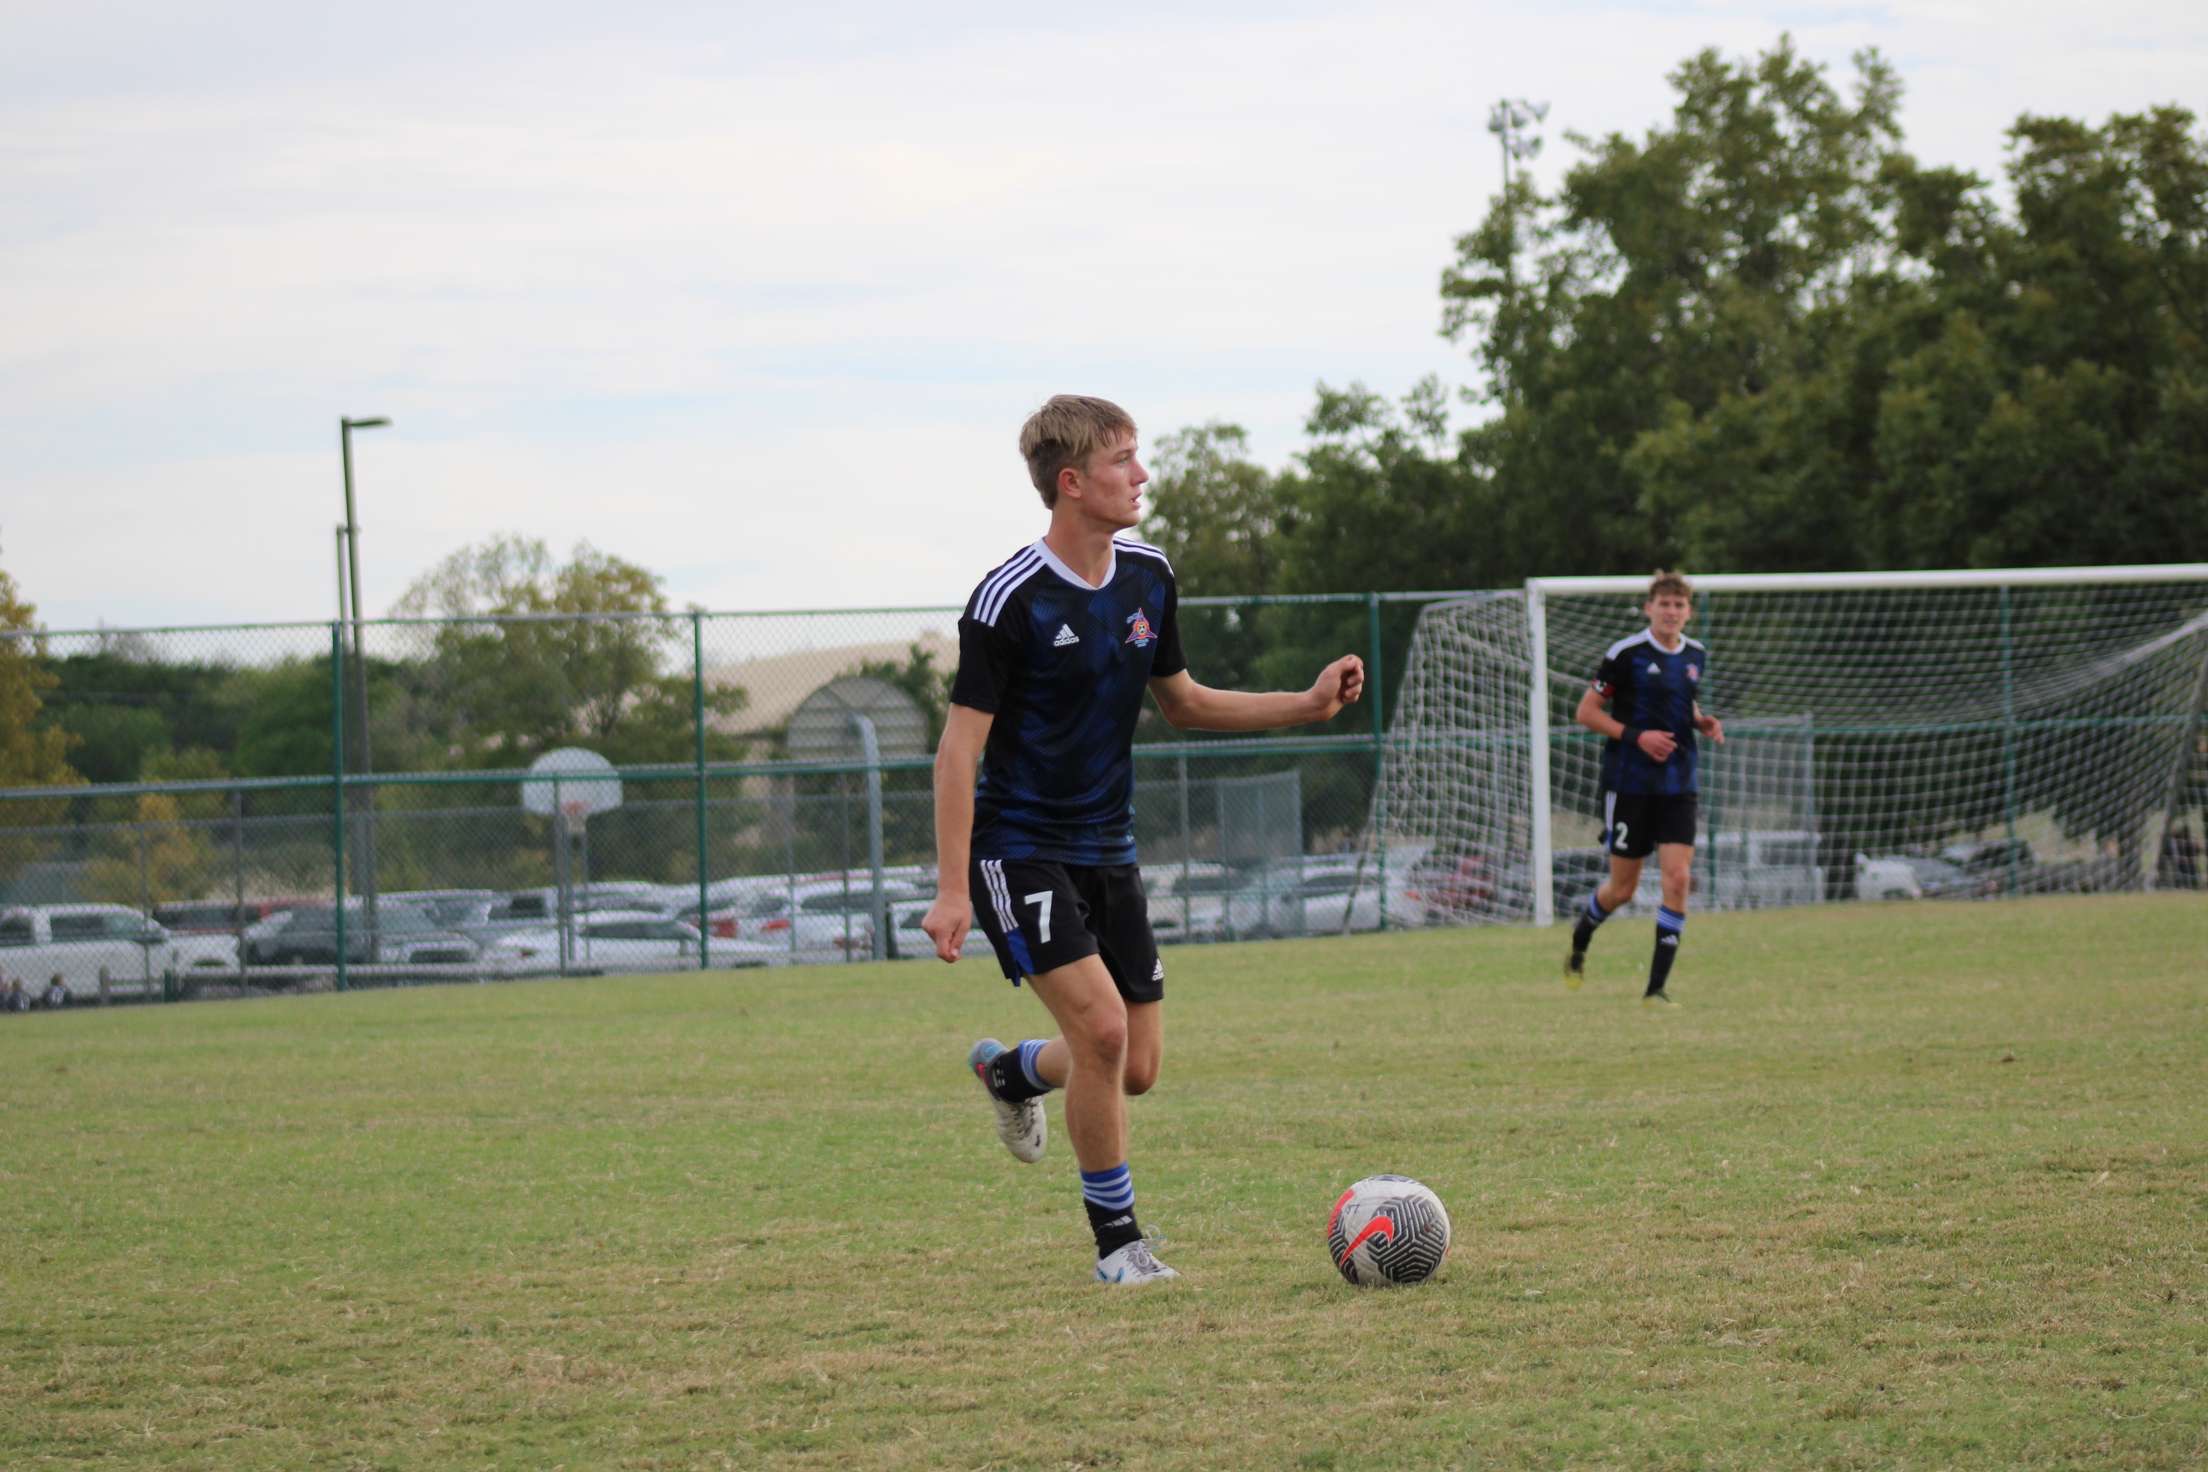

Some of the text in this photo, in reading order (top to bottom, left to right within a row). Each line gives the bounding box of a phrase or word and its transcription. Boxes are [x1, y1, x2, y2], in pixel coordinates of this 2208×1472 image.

[1053, 635, 1080, 647] adidas
[1615, 821, 1628, 849] 2
[1024, 890, 1053, 944] 7
